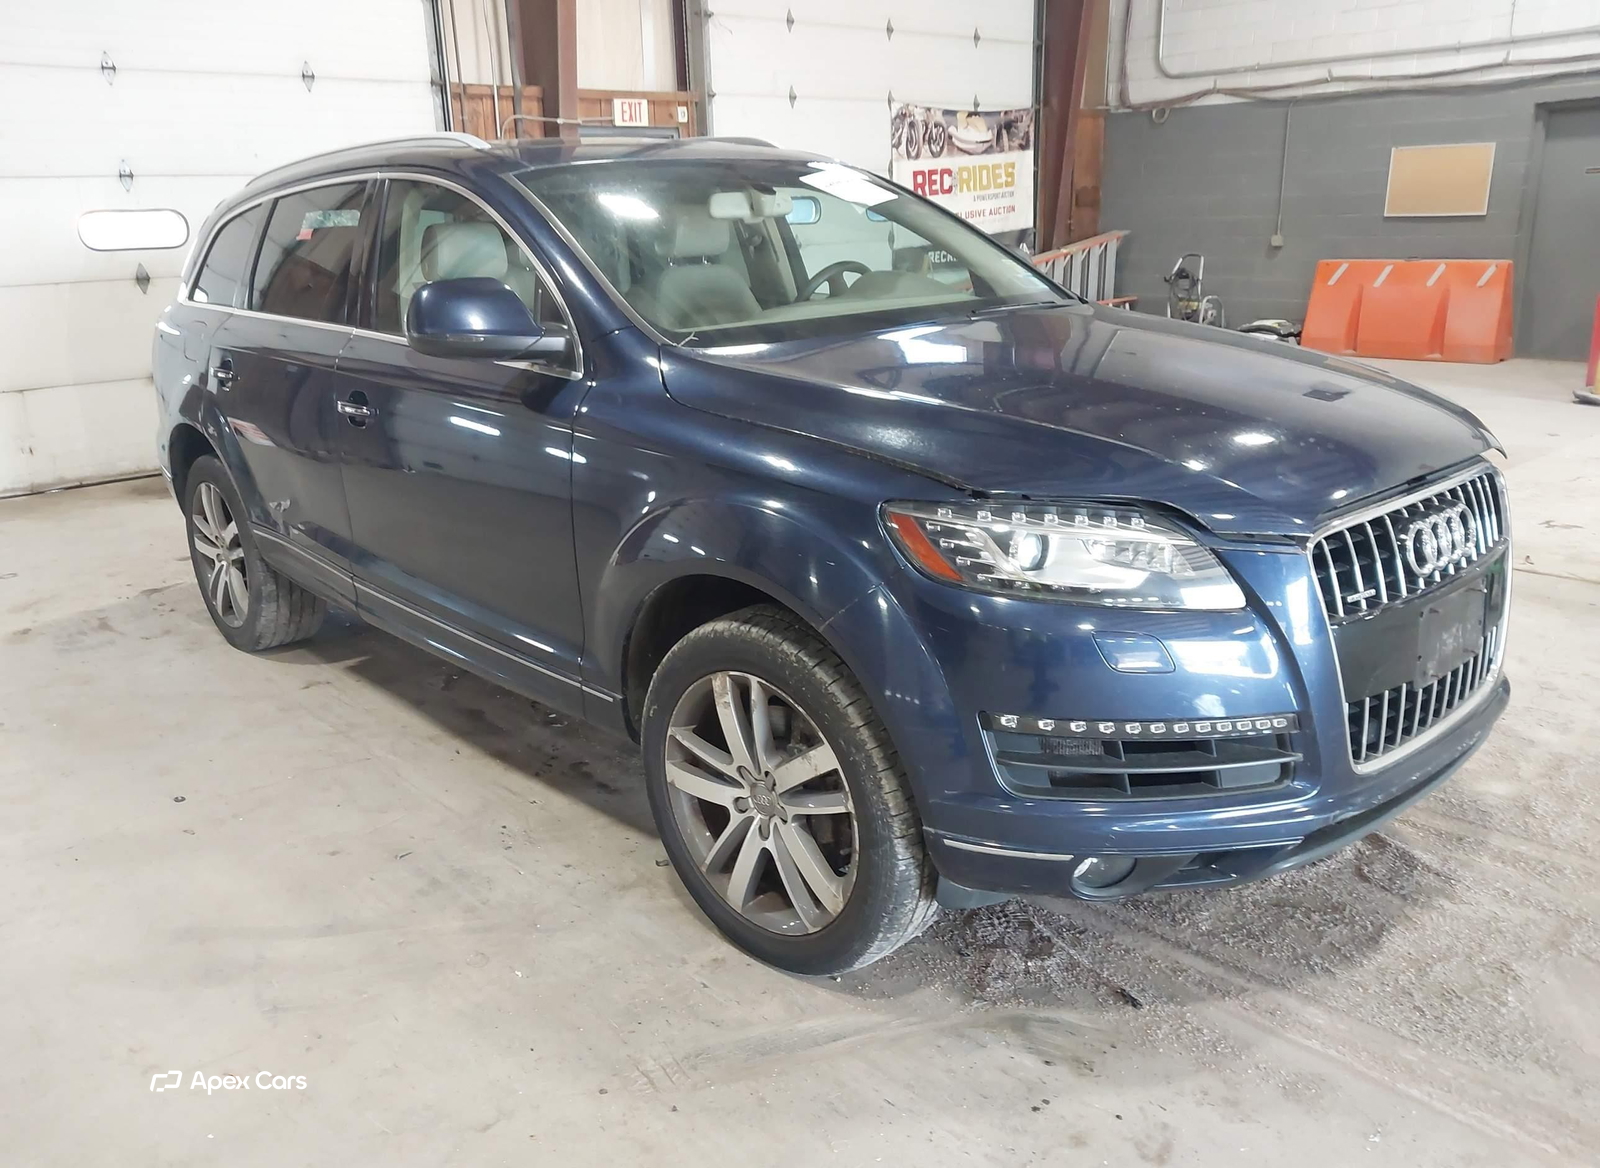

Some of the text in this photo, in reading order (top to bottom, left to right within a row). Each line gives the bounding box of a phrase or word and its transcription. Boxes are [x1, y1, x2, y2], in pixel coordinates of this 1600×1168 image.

[621, 101, 643, 123] EXIT
[913, 168, 953, 198] REC
[958, 161, 1016, 193] RIDES
[989, 204, 1016, 216] AUCTION
